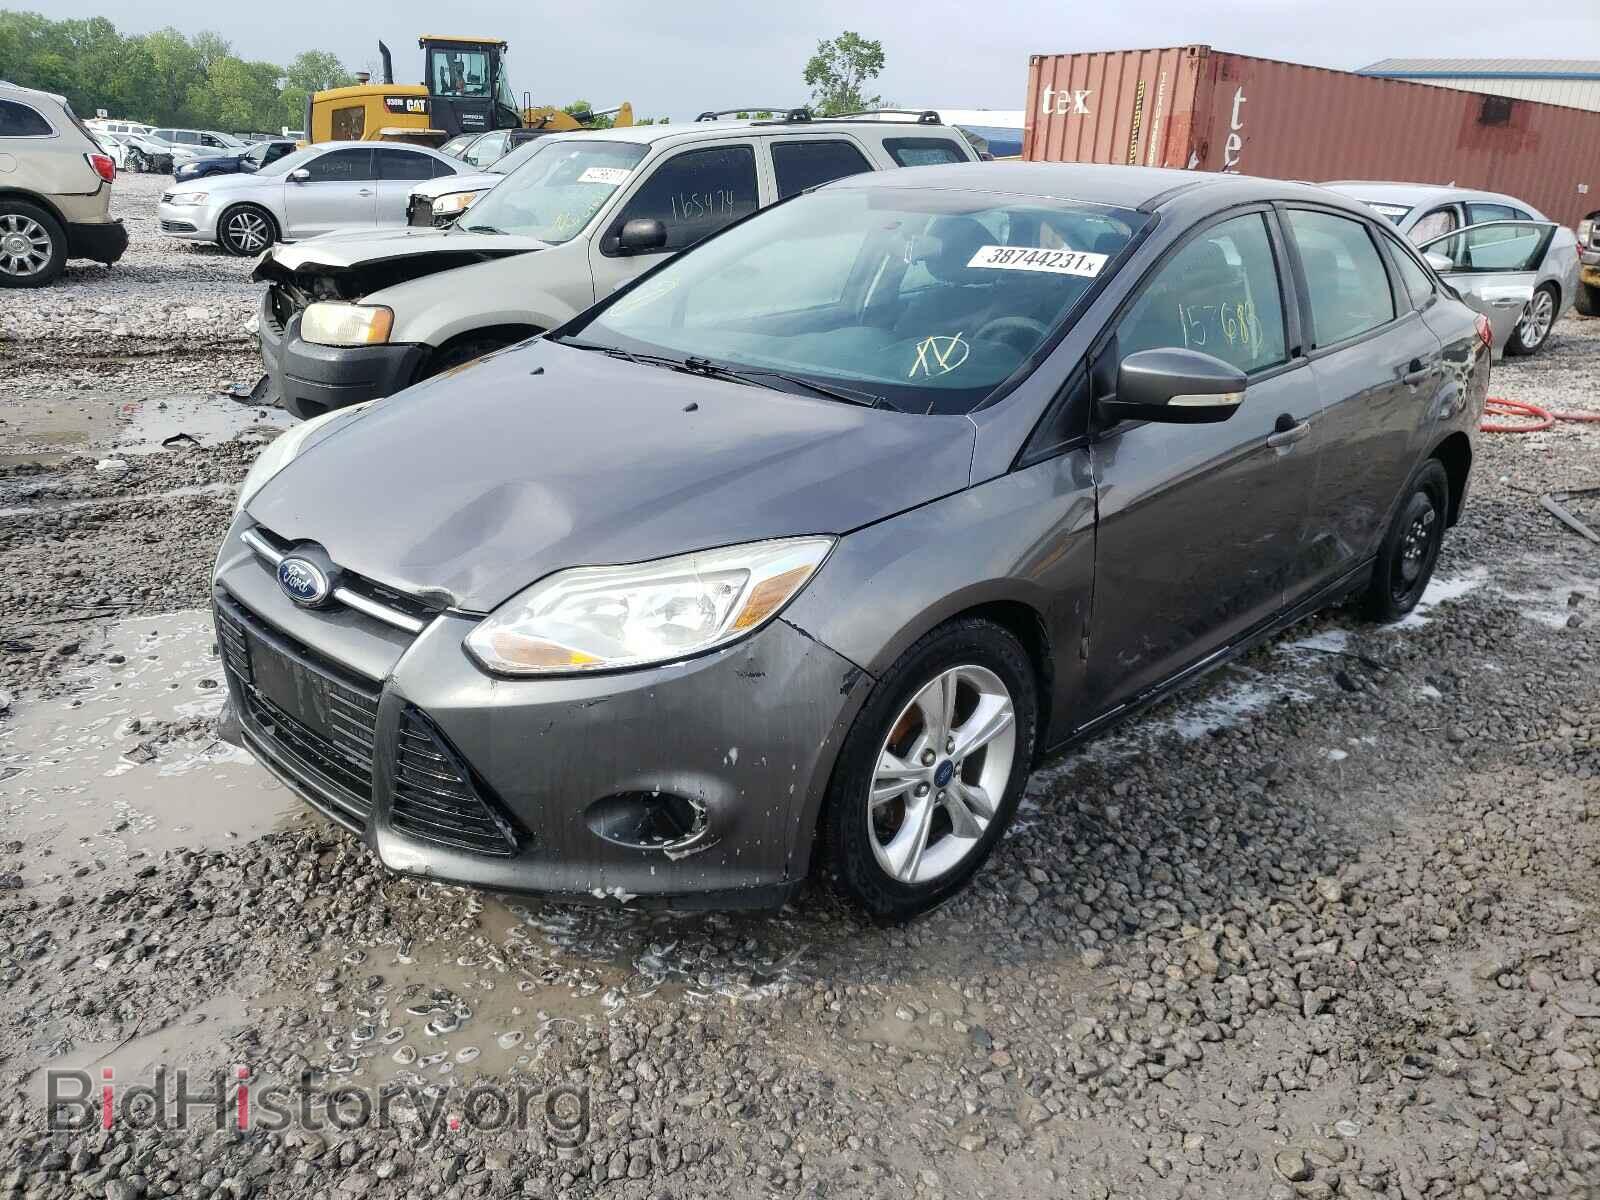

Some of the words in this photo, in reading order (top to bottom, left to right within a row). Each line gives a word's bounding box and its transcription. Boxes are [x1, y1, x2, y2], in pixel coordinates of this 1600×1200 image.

[406, 99, 426, 112] CAT
[1042, 84, 1092, 116] tex
[1224, 86, 1247, 174] te
[987, 248, 1088, 271] 38744231
[283, 564, 312, 593] Ford
